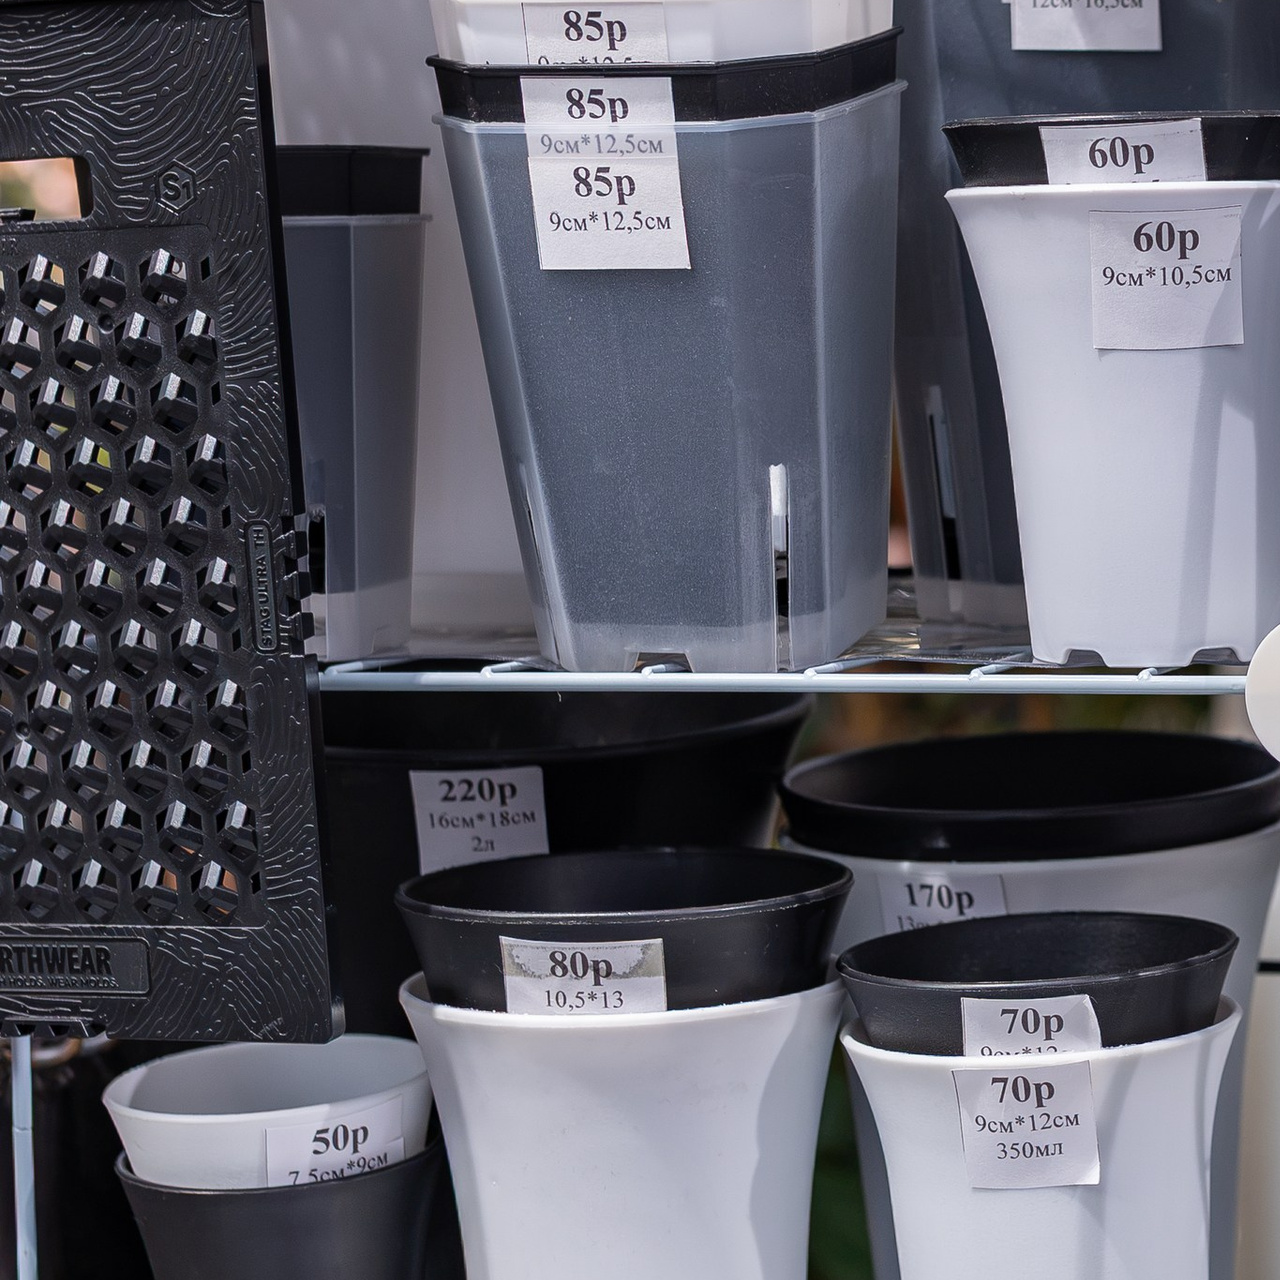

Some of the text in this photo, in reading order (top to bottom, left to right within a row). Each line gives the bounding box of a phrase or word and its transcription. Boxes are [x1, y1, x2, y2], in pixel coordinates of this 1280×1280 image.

[563, 10, 627, 51] 85р
[565, 87, 629, 125] 85р
[1088, 135, 1155, 175] 60р
[572, 167, 636, 206] 85р
[1132, 220, 1200, 261] 60р
[439, 777, 517, 807] 220р
[471, 835, 495, 852] 2л
[904, 882, 975, 917] 170р
[0, 944, 112, 975] RTHWEAR
[549, 950, 613, 987] 80р
[1000, 1007, 1064, 1041] 70р
[990, 1076, 1055, 1109] 70р
[312, 1124, 369, 1154] 50р
[996, 1138, 1063, 1160] 350мл
